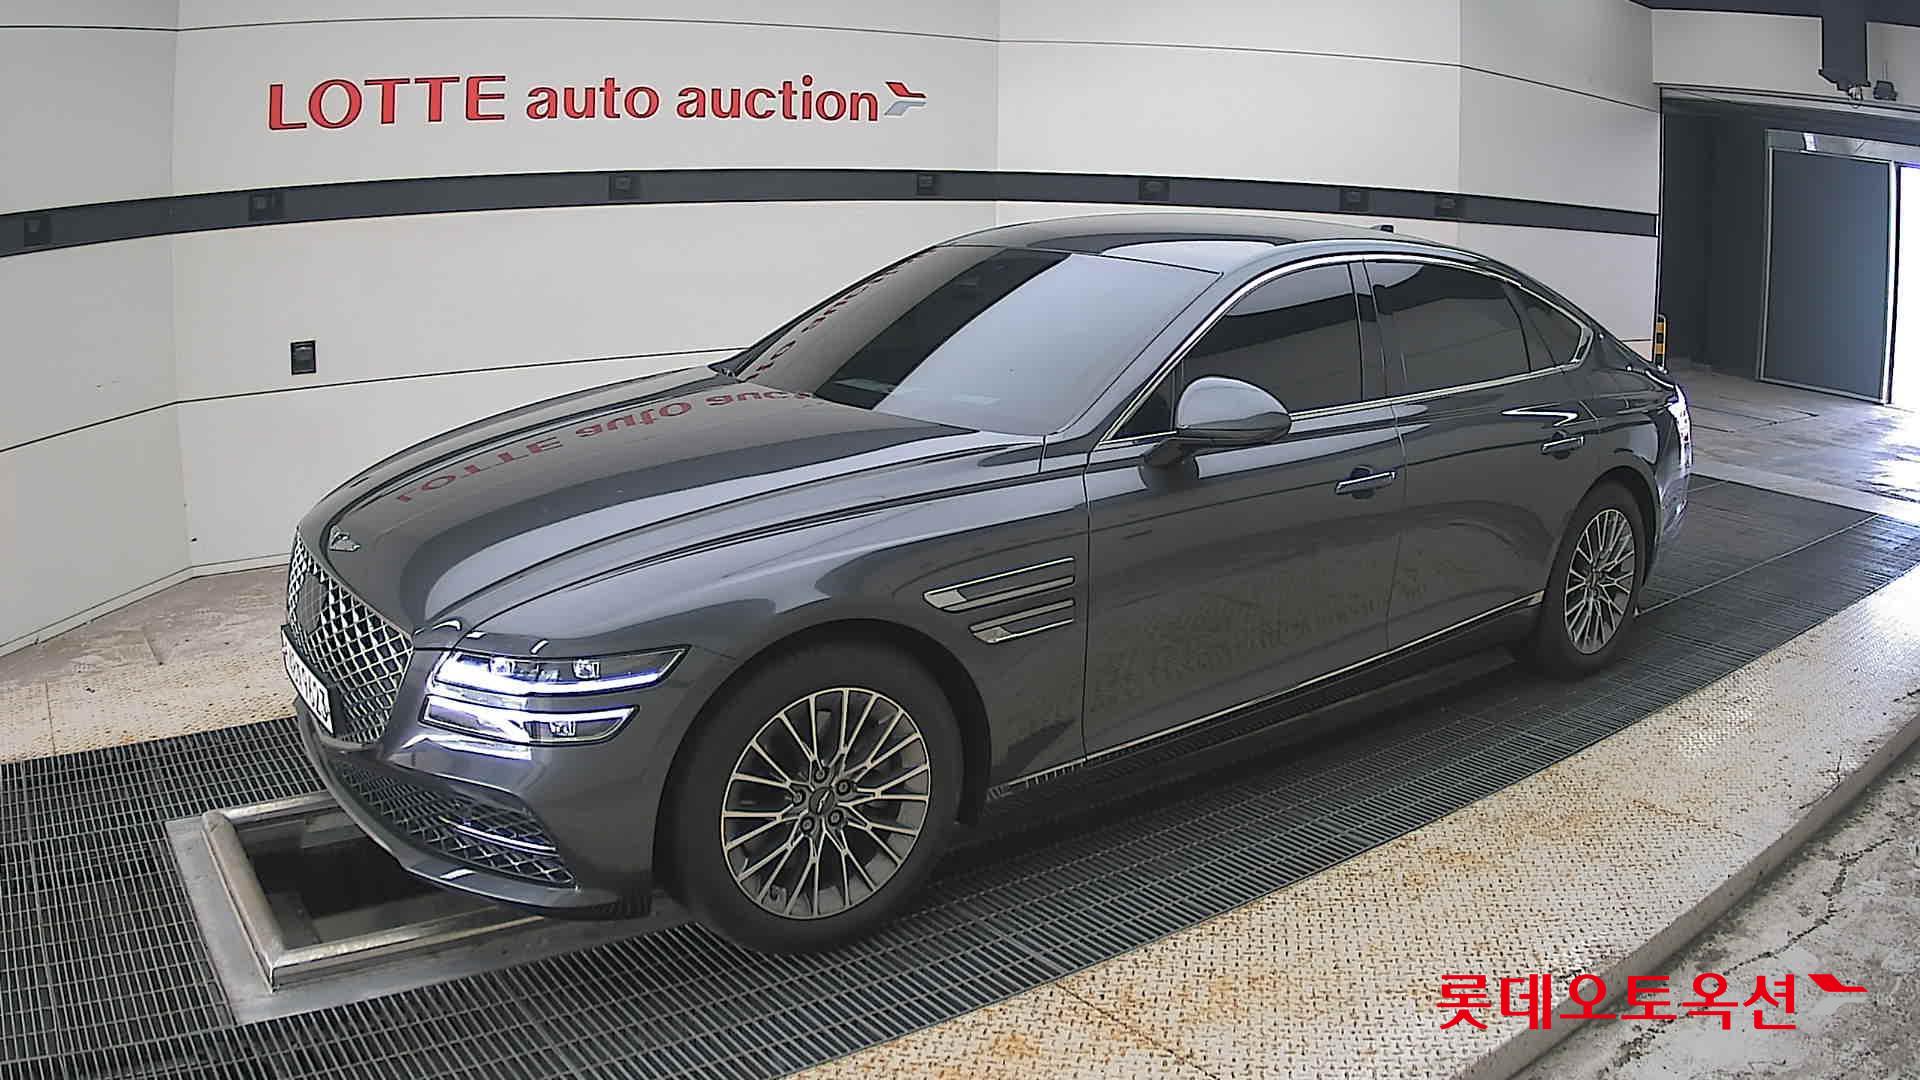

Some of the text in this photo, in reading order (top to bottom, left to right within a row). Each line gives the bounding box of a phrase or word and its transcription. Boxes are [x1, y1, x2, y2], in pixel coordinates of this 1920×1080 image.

[268, 75, 880, 131] LOTTE auto auction
